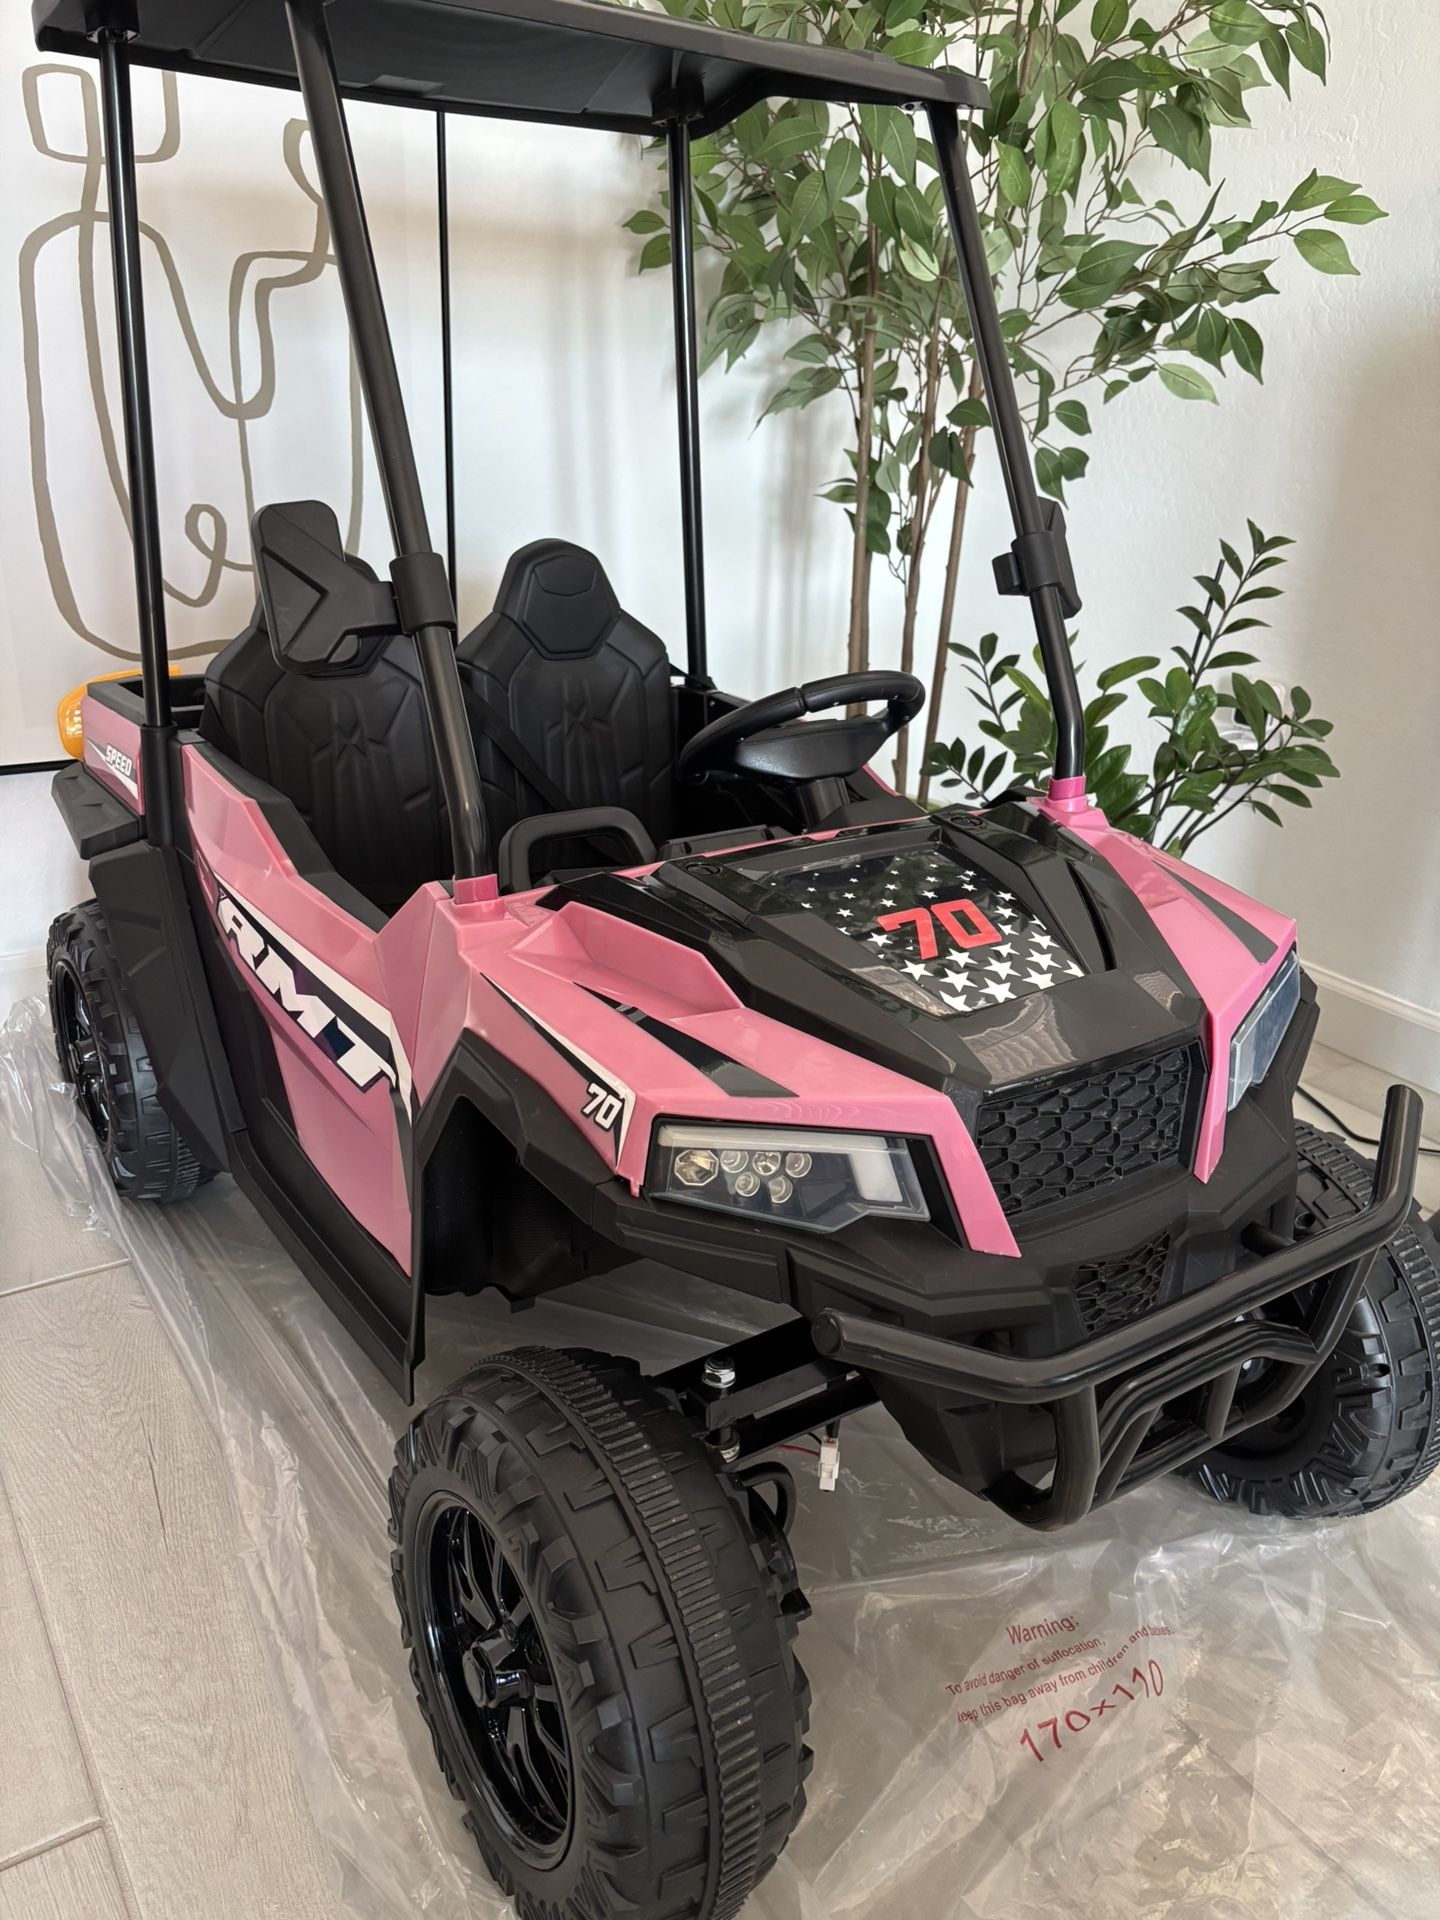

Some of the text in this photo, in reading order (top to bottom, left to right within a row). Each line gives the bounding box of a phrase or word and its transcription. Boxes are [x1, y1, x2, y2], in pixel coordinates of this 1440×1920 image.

[105, 744, 133, 777] SPEED
[877, 898, 1002, 960] 70
[582, 1082, 623, 1130] 70
[1006, 1615, 1080, 1645] Warning:
[945, 1637, 1106, 1695] To avoid danger of suffocation,
[980, 1700, 1002, 1716] this
[1002, 1691, 1027, 1709] bag
[1028, 1680, 1058, 1699] away
[1058, 1670, 1087, 1688] from
[1088, 1644, 1129, 1676] children
[1129, 1624, 1149, 1644] and
